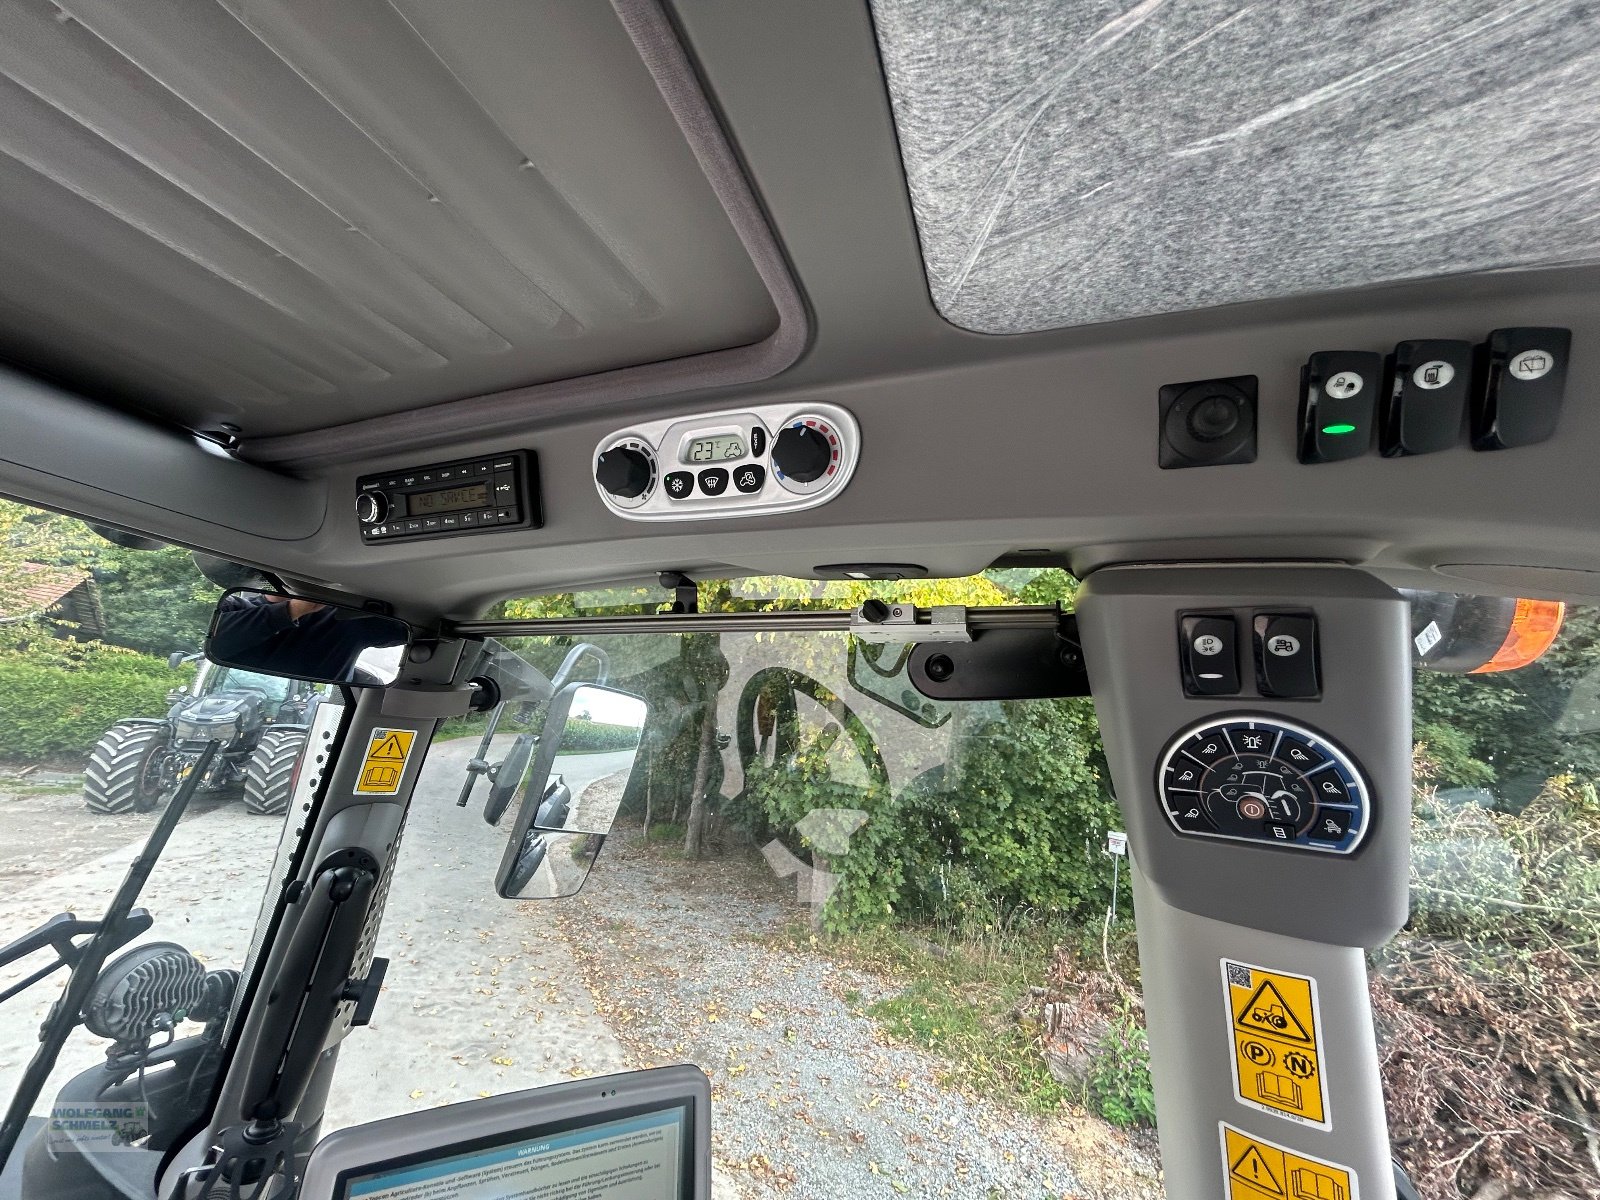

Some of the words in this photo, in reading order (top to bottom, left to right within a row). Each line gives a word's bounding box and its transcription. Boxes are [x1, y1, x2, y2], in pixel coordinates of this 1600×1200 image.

[694, 442, 712, 460] 23
[1250, 1044, 1264, 1060] P
[1290, 1056, 1307, 1074] N
[518, 1144, 550, 1156] WARNUNG
